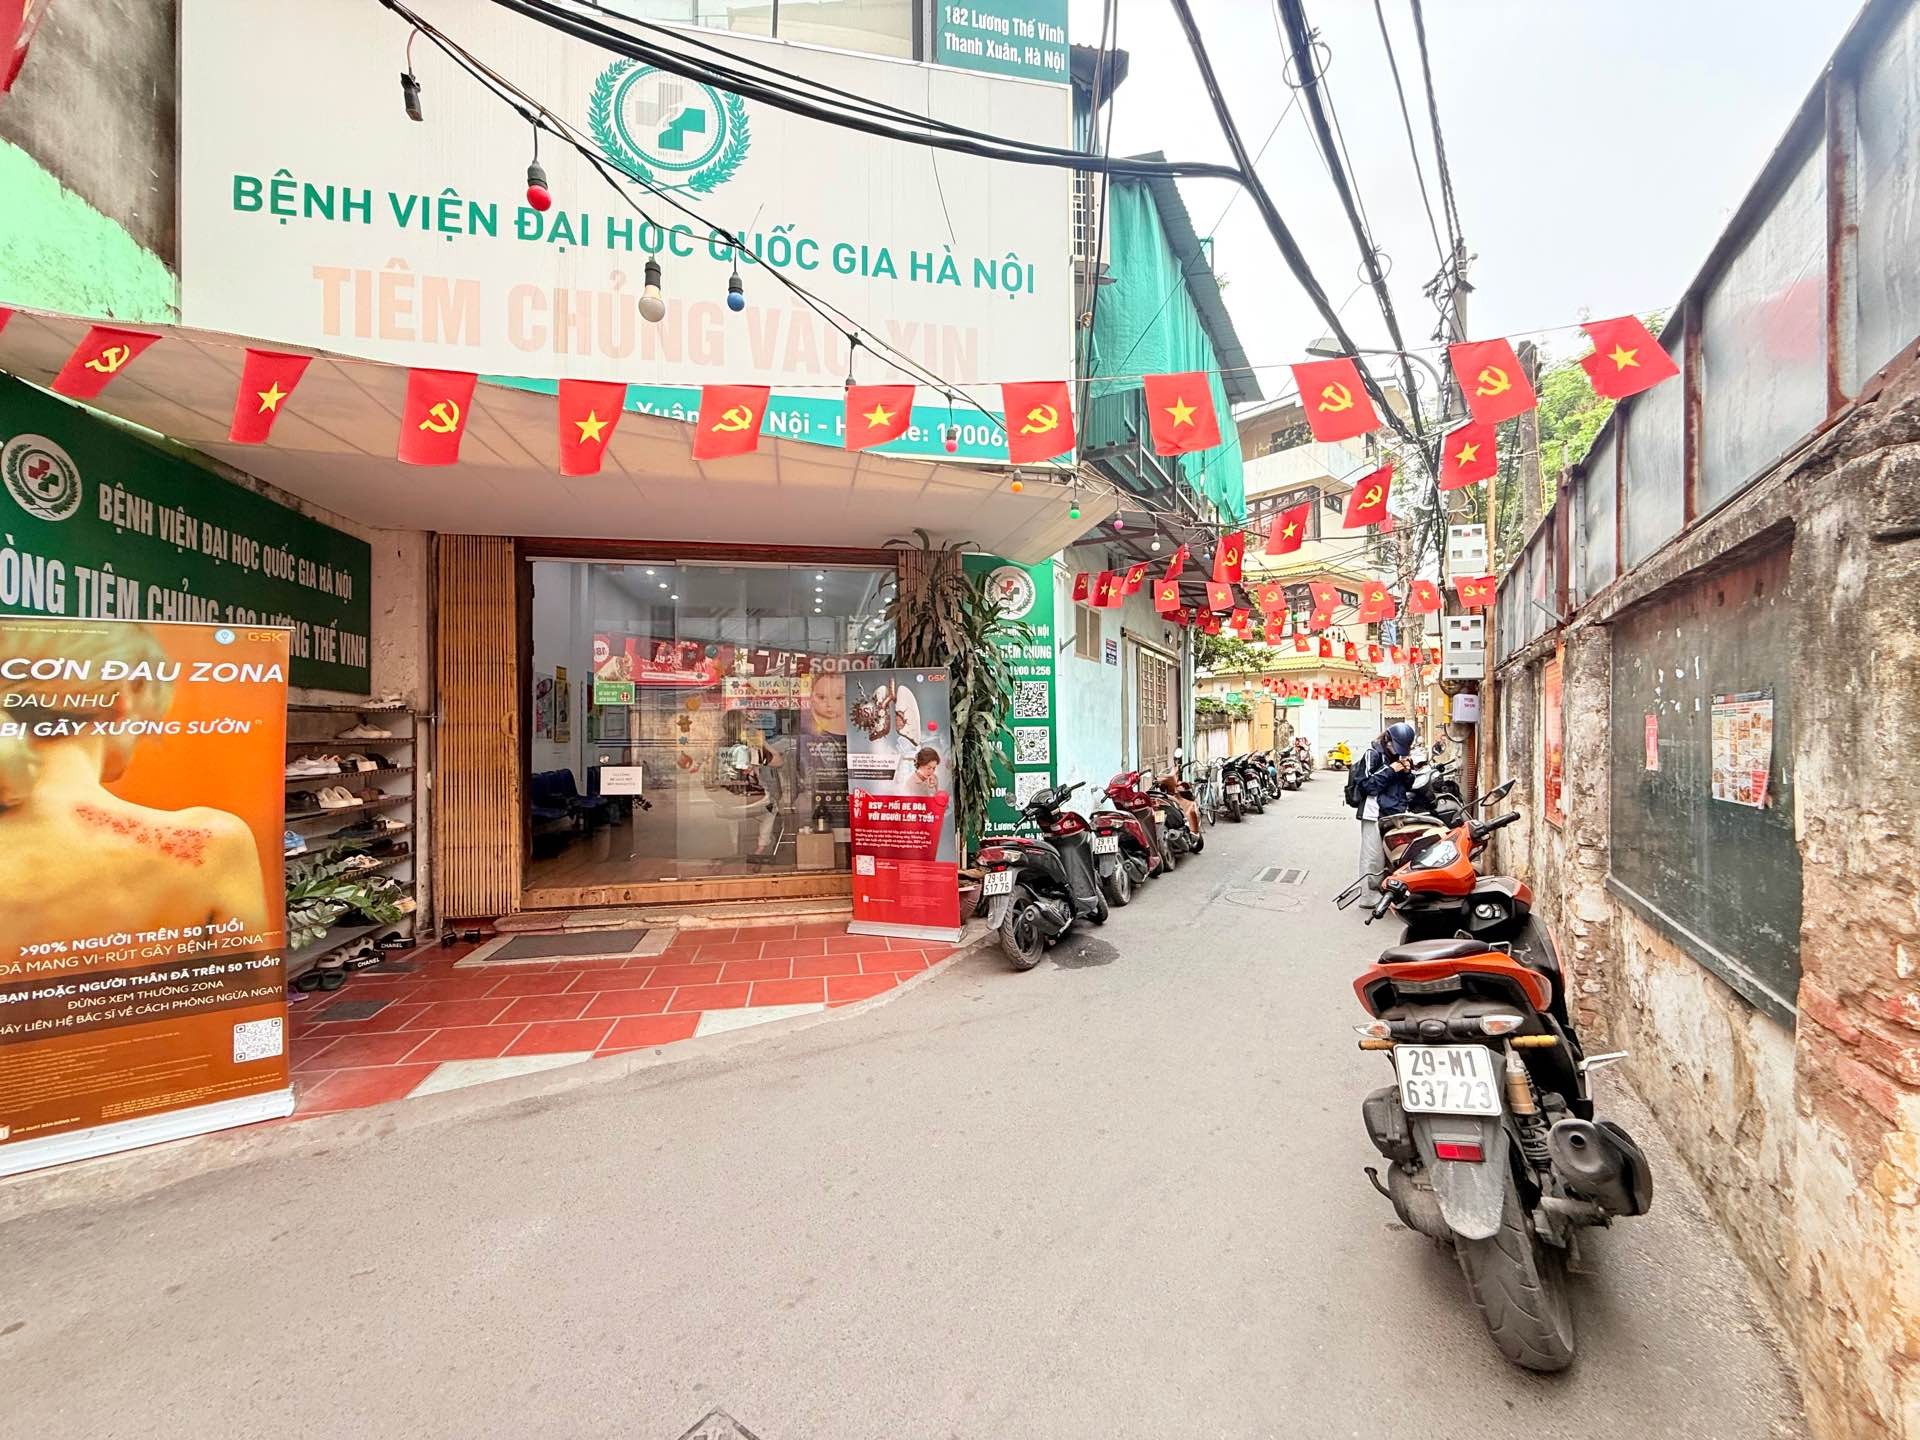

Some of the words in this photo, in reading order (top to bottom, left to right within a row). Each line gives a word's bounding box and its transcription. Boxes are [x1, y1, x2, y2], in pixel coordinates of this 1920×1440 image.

[944, 5, 968, 26] 182
[971, 9, 1009, 36] Lương
[1012, 18, 1035, 39] Thế
[1037, 22, 1065, 45] Vinh
[944, 31, 983, 56] Thanh
[985, 39, 1022, 65] Xuân,
[1024, 46, 1041, 67] Hà
[1044, 49, 1065, 74] Nội
[232, 167, 372, 225] BỆNH
[387, 187, 498, 242] VIỆN
[513, 205, 589, 253] ĐẠI
[707, 223, 820, 271] QUỐC
[832, 242, 898, 280] GIA
[909, 244, 962, 287] HÀ
[973, 252, 1034, 300] NỘI
[312, 257, 481, 348] TIÊM
[506, 270, 726, 370] CHỦNG
[883, 318, 979, 385] XIN
[769, 410, 810, 439] Nội
[99, 482, 153, 536] BỆNH
[158, 506, 198, 553] VIỆN
[202, 522, 228, 565] ĐẠI
[232, 533, 260, 574] HỌC
[263, 542, 295, 582] QUỐC
[298, 558, 317, 588] GIA
[319, 562, 334, 595] HÀ
[335, 569, 353, 604] NỘI
[0, 533, 65, 615] ÒNG
[74, 562, 140, 620] TIÊM
[313, 618, 338, 663] THẾ
[339, 631, 367, 668] VINH
[247, 631, 284, 643] GSK
[0, 657, 92, 681] CƠN
[100, 659, 182, 682] ĐAU
[188, 662, 284, 683] ZONA
[3, 693, 58, 708] ĐAU
[63, 691, 120, 708] NHƯ
[0, 721, 27, 740] BỊ
[33, 718, 89, 737] GÃY
[91, 719, 181, 736] XƯƠNG
[186, 717, 251, 735] SƯỜN
[20, 941, 68, 957] >90%
[72, 932, 131, 951] NGƯỜI
[136, 927, 179, 943] TRÊN
[183, 926, 203, 938] 50
[205, 917, 244, 935] TUỔI
[26, 956, 79, 973] MANG
[83, 948, 138, 965] VI-RÚT
[141, 944, 174, 958] GÂY
[177, 939, 218, 954] BỆNH
[221, 934, 264, 949] ZONA
[32, 984, 76, 1000] HOẶC
[79, 977, 127, 993] NGƯỜI
[129, 972, 168, 985] THÂN
[170, 969, 190, 980] ĐÃ
[192, 963, 225, 977] TRÊN
[227, 962, 243, 973] 50
[245, 954, 280, 970] TUỔI?
[357, 957, 380, 968] CHANEL
[24, 1019, 53, 1032] LIÊN
[55, 1015, 74, 1027] HỆ
[76, 1011, 102, 1024] BÁC
[104, 1008, 116, 1020] SĨ
[135, 1001, 169, 1015] CÁCH
[172, 995, 214, 1009] PHÒNG
[216, 990, 249, 1003] NGỪA
[250, 985, 282, 998] NGAY!
[108, 992, 134, 1004] XEM
[137, 984, 189, 999] THƯỜNG
[191, 979, 224, 992] ZONA
[1408, 1049, 1477, 1078] 29-M1
[1406, 1080, 1493, 1110] 637.23
